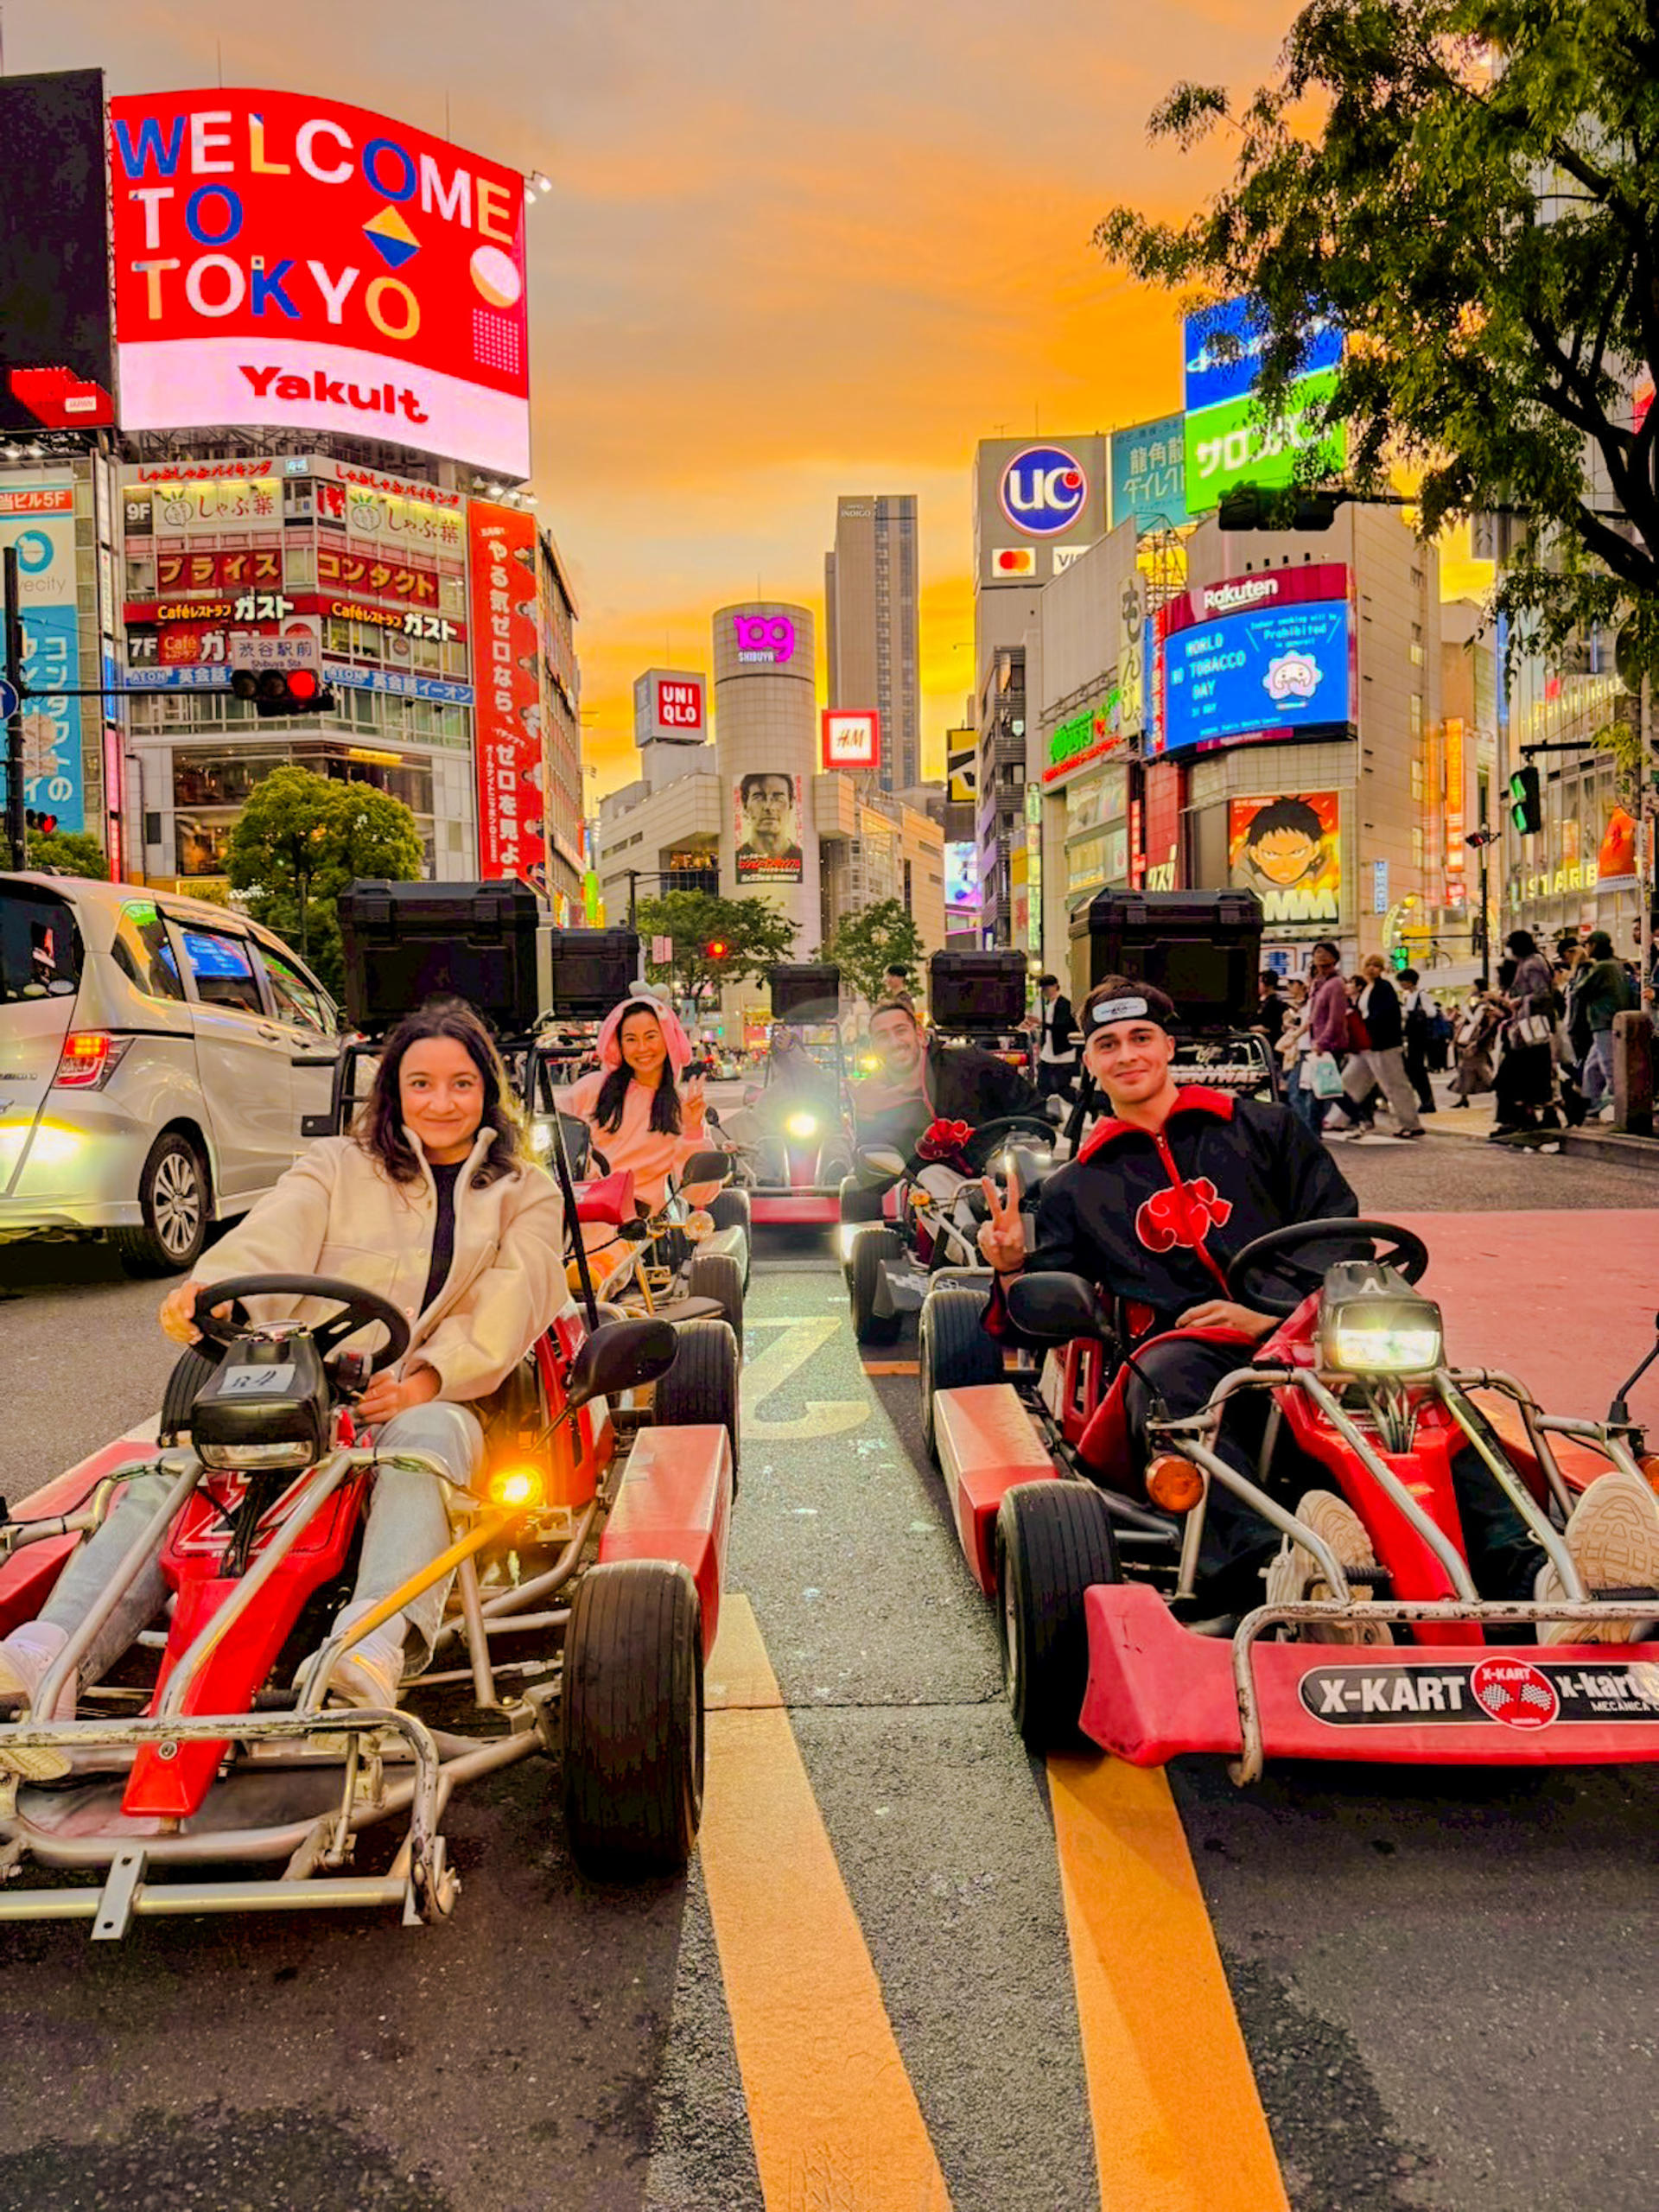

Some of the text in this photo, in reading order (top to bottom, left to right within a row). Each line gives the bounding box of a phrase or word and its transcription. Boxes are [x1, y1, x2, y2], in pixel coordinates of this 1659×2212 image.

[114, 111, 513, 245] WELCOME
[128, 183, 244, 249] TO
[131, 254, 421, 340] TOKYO
[238, 365, 429, 423] Yakult
[126, 502, 151, 521] 9F
[200, 491, 274, 518] しゃぶ葉
[389, 506, 460, 544] しゃぶ葉
[159, 553, 279, 584] プライス
[1057, 553, 1084, 567] VI
[20, 576, 67, 594] ecity
[318, 553, 435, 598] コンタクト
[233, 595, 295, 621] ガスト
[1204, 578, 1279, 608] Rakuten
[404, 612, 458, 642] ガスト
[733, 615, 795, 664] 109
[130, 638, 158, 658] 7F
[239, 640, 312, 658] 渋谷駅前
[1189, 650, 1246, 678] TOBACCO
[662, 685, 694, 704] UNI
[663, 704, 697, 724] QLO
[1255, 888, 1338, 922] MM
[1482, 1667, 1532, 1681] X-KART
[1319, 1675, 1466, 1713] X-KART
